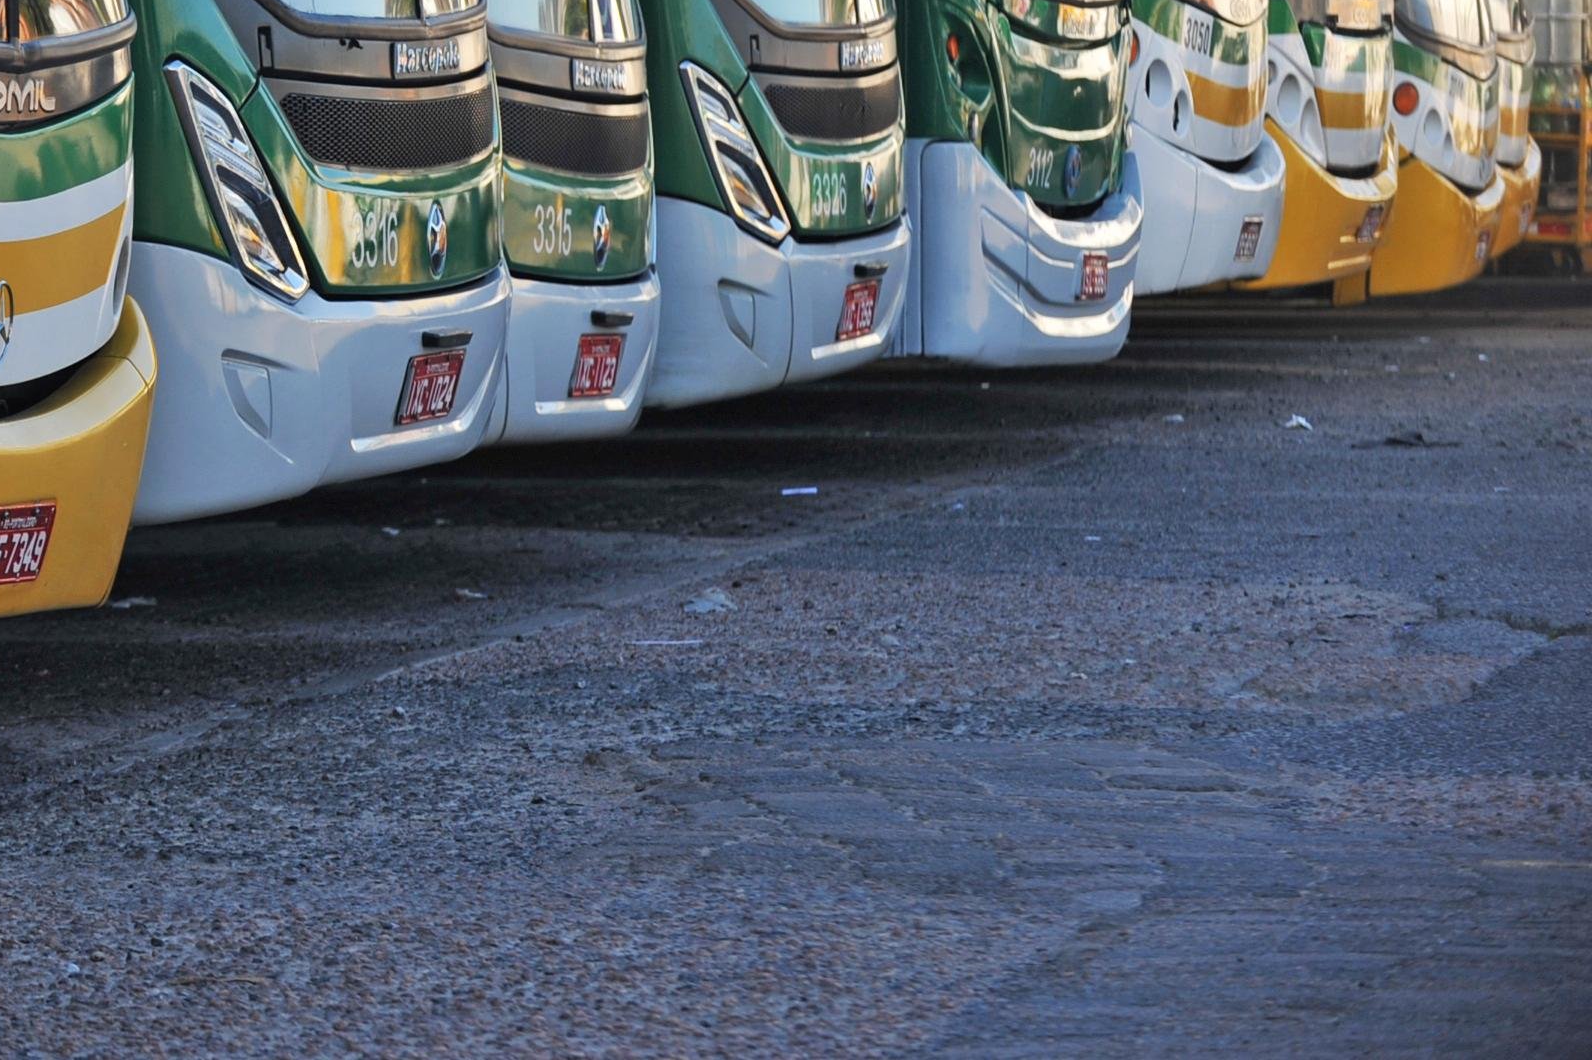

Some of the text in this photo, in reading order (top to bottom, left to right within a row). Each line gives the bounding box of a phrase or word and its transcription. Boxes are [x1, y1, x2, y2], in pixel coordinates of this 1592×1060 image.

[1184, 17, 1210, 55] 3050
[1027, 147, 1054, 188] 3112
[812, 172, 847, 216] 3326
[351, 211, 399, 268] 3316
[533, 204, 572, 256] 3315
